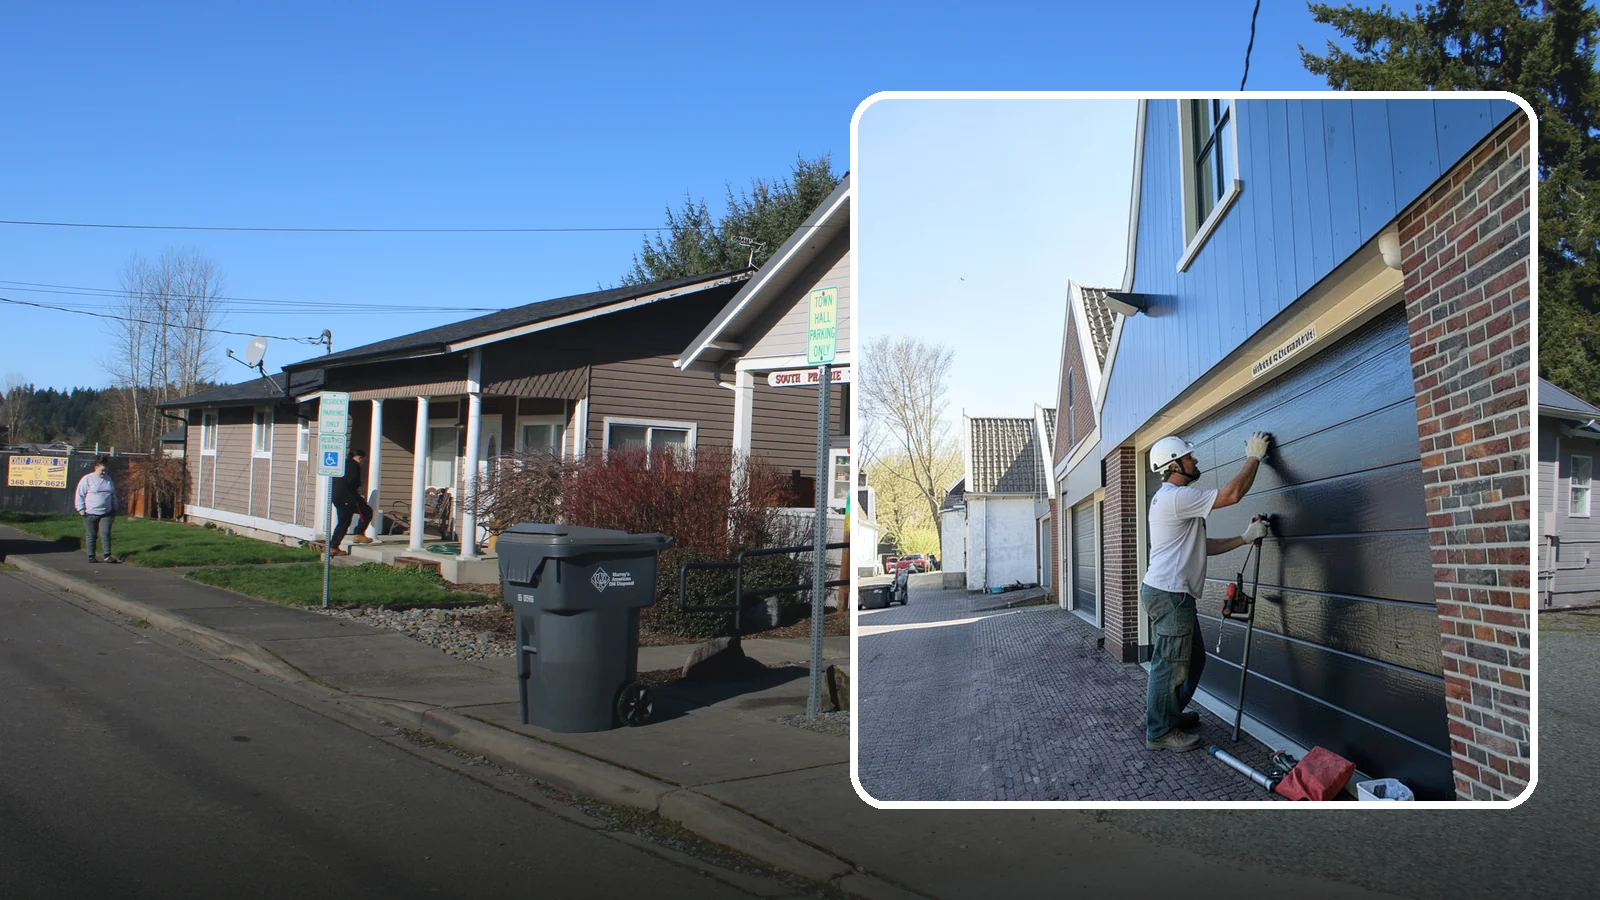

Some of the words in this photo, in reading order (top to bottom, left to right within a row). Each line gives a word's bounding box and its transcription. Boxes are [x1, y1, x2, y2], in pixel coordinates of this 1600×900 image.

[814, 295, 833, 308] TOWN
[814, 312, 831, 324] HALL
[810, 327, 836, 340] PARKING
[814, 344, 831, 357] ONLY
[776, 373, 801, 384] SOUTH
